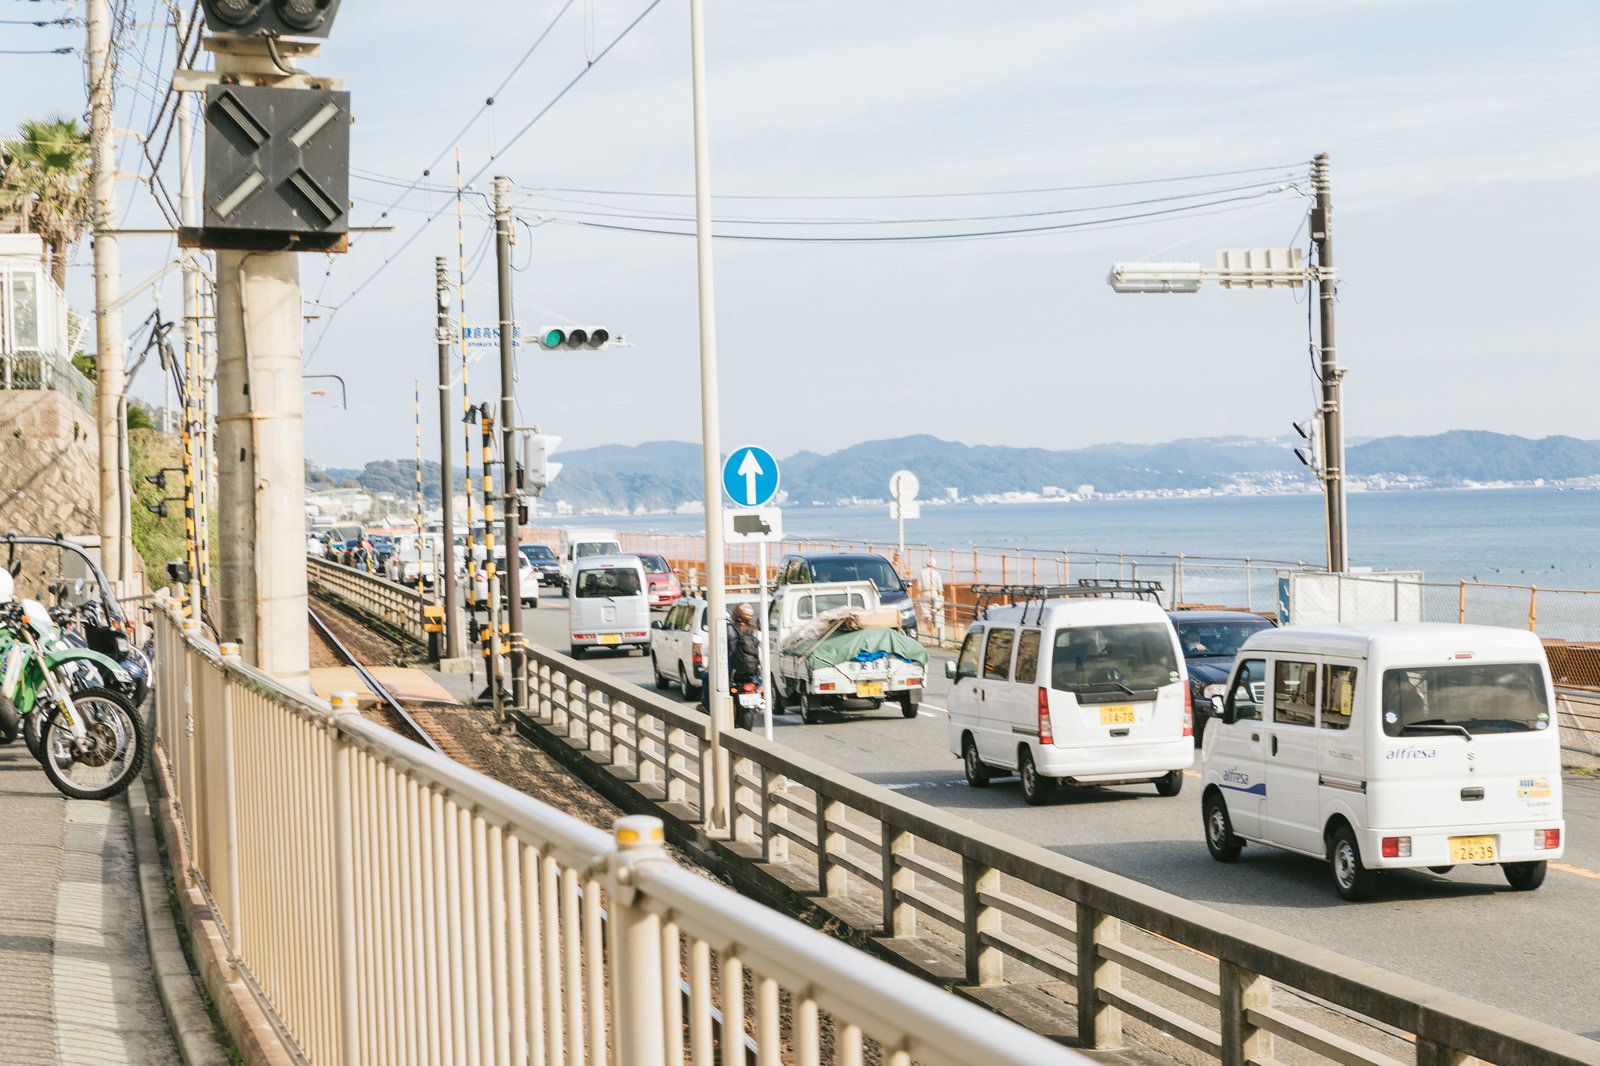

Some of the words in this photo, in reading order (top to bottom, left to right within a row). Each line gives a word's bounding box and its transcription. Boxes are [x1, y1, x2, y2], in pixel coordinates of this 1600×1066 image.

[1384, 748, 1437, 760] alfresa
[1223, 768, 1249, 785] alfresa
[1459, 846, 1493, 860] 26-39
